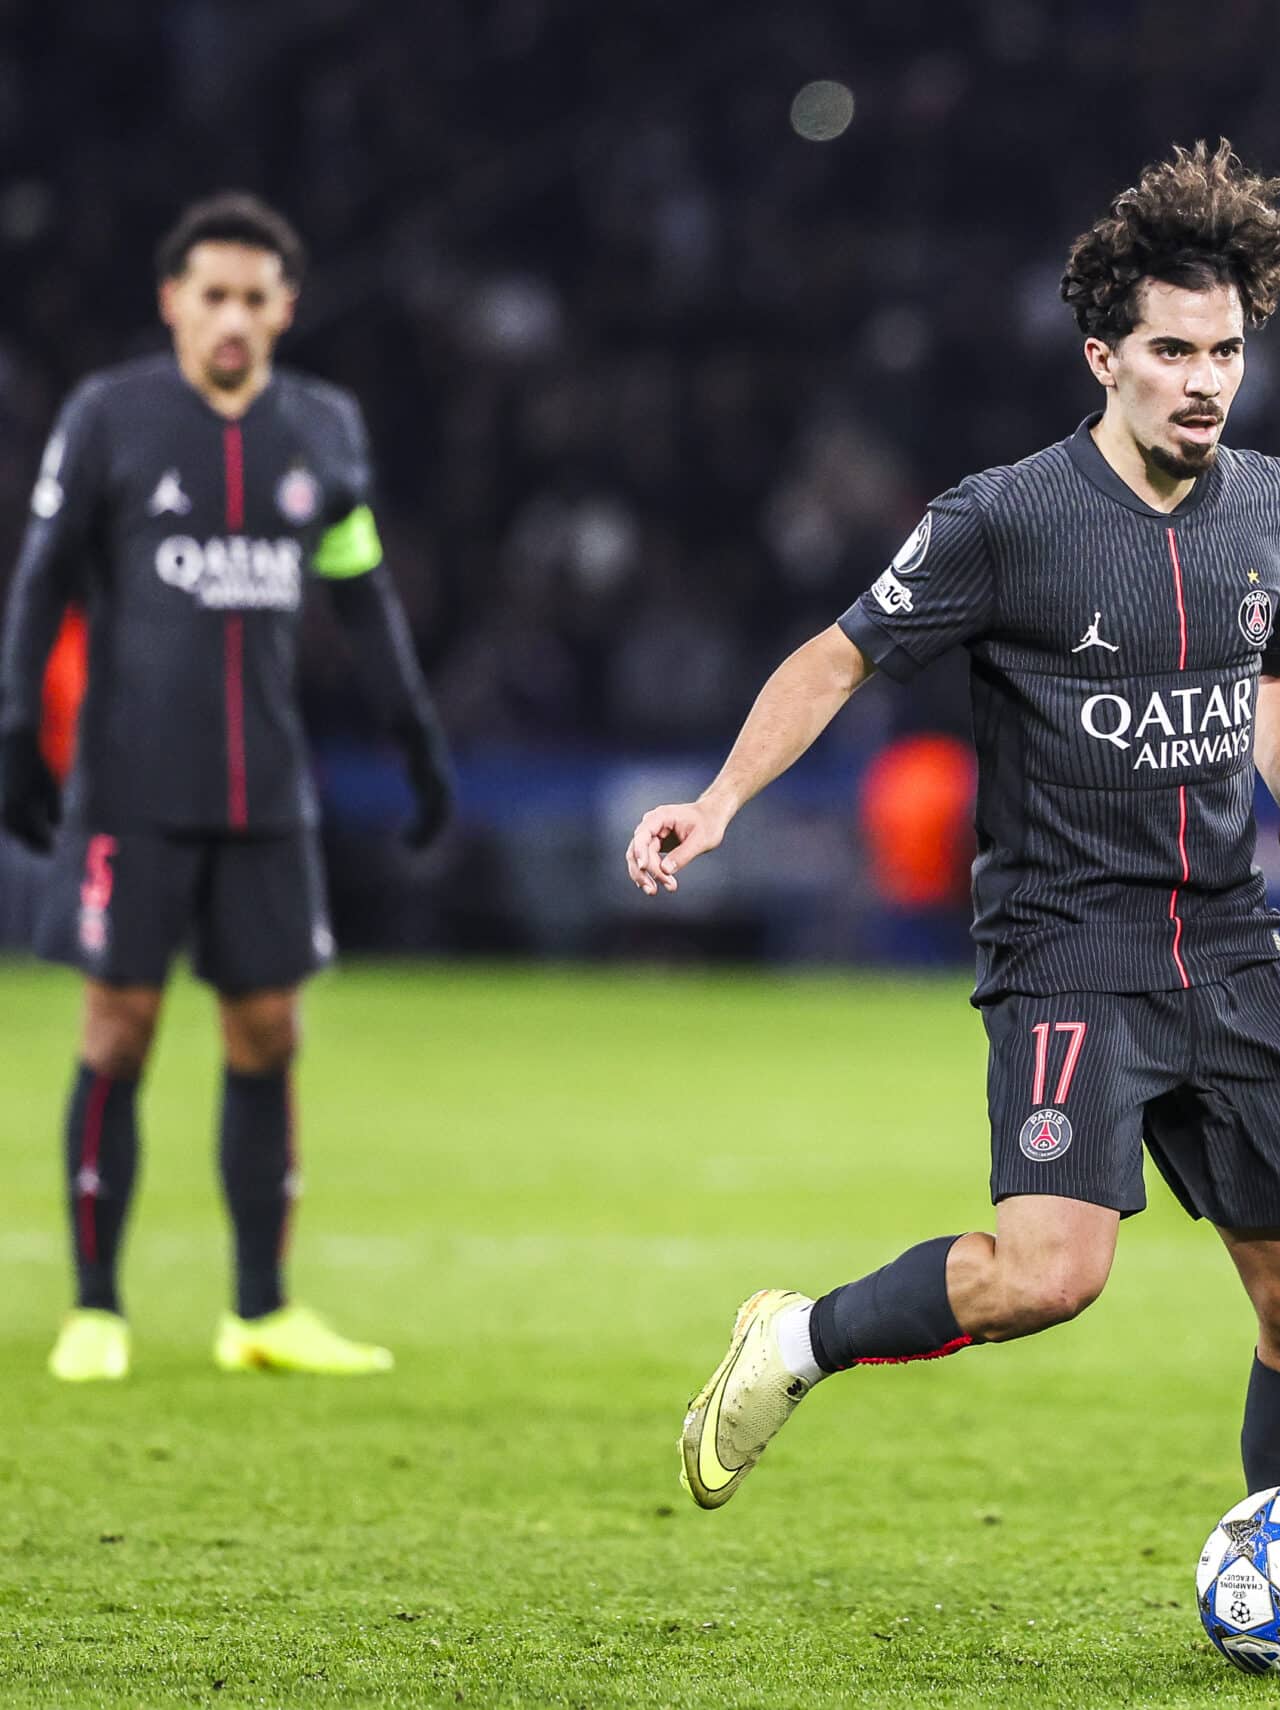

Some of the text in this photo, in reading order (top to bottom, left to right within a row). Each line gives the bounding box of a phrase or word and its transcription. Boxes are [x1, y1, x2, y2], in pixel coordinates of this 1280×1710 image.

[1080, 678, 1253, 750] QATAR
[1133, 725, 1250, 770] AIRWAYS
[1032, 1022, 1087, 1105] 17
[1030, 1111, 1065, 1125] PARIS
[1220, 1581, 1263, 1590] CHAMPIONS
